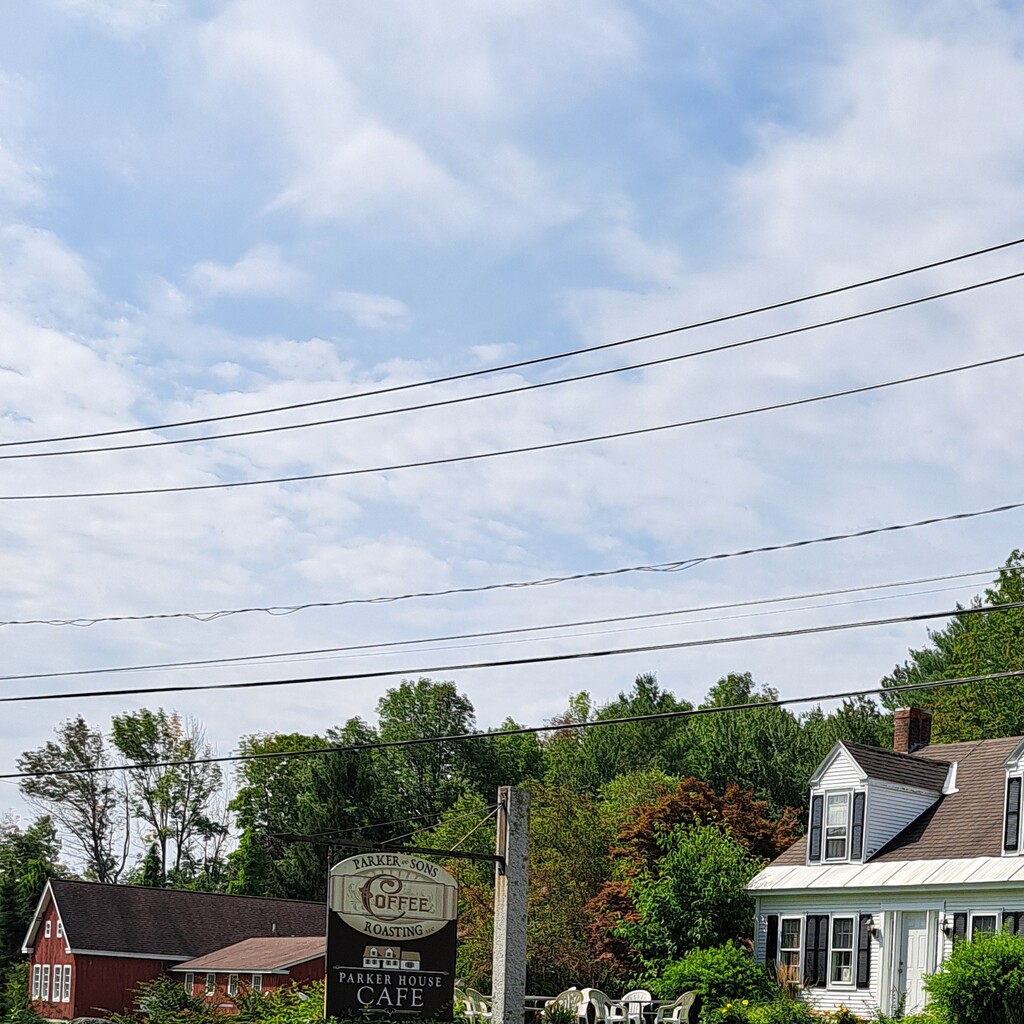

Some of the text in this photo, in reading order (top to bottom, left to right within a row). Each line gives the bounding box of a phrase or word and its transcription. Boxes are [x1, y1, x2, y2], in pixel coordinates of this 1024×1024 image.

[353, 855, 439, 878] PARKER SONS
[359, 874, 430, 921] COFFEE
[364, 921, 423, 937] ROASTING
[339, 972, 442, 987] PARKER HOUSE
[357, 986, 424, 1007] CAFE
